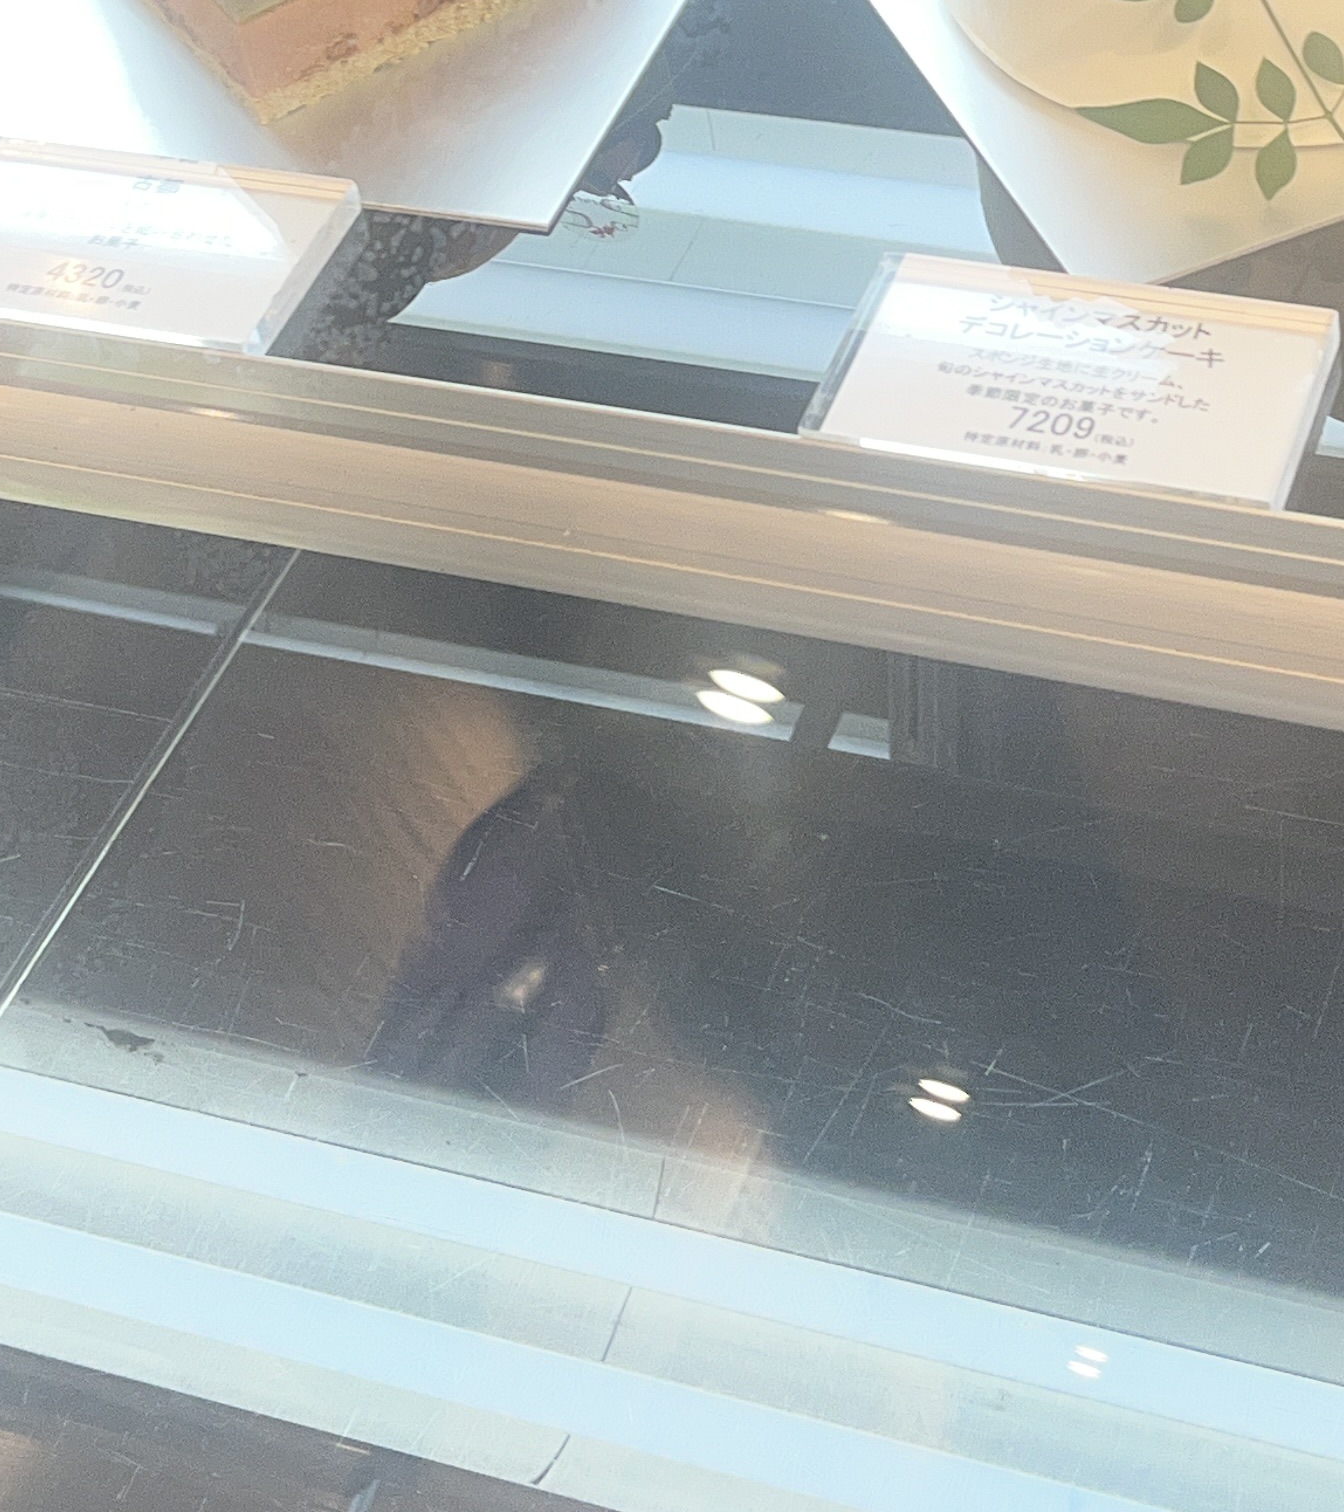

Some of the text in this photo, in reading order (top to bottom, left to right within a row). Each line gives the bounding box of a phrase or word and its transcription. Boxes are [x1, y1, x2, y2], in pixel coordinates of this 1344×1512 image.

[46, 260, 125, 289] 4320
[989, 295, 1211, 340] シャインマスカット
[959, 315, 1225, 368] デコレーションケーキ
[937, 360, 1212, 412] 旬のシャインマスカットをサンドした
[966, 383, 1159, 425] 季節限定のお菓子です。
[1008, 406, 1096, 440] 7209
